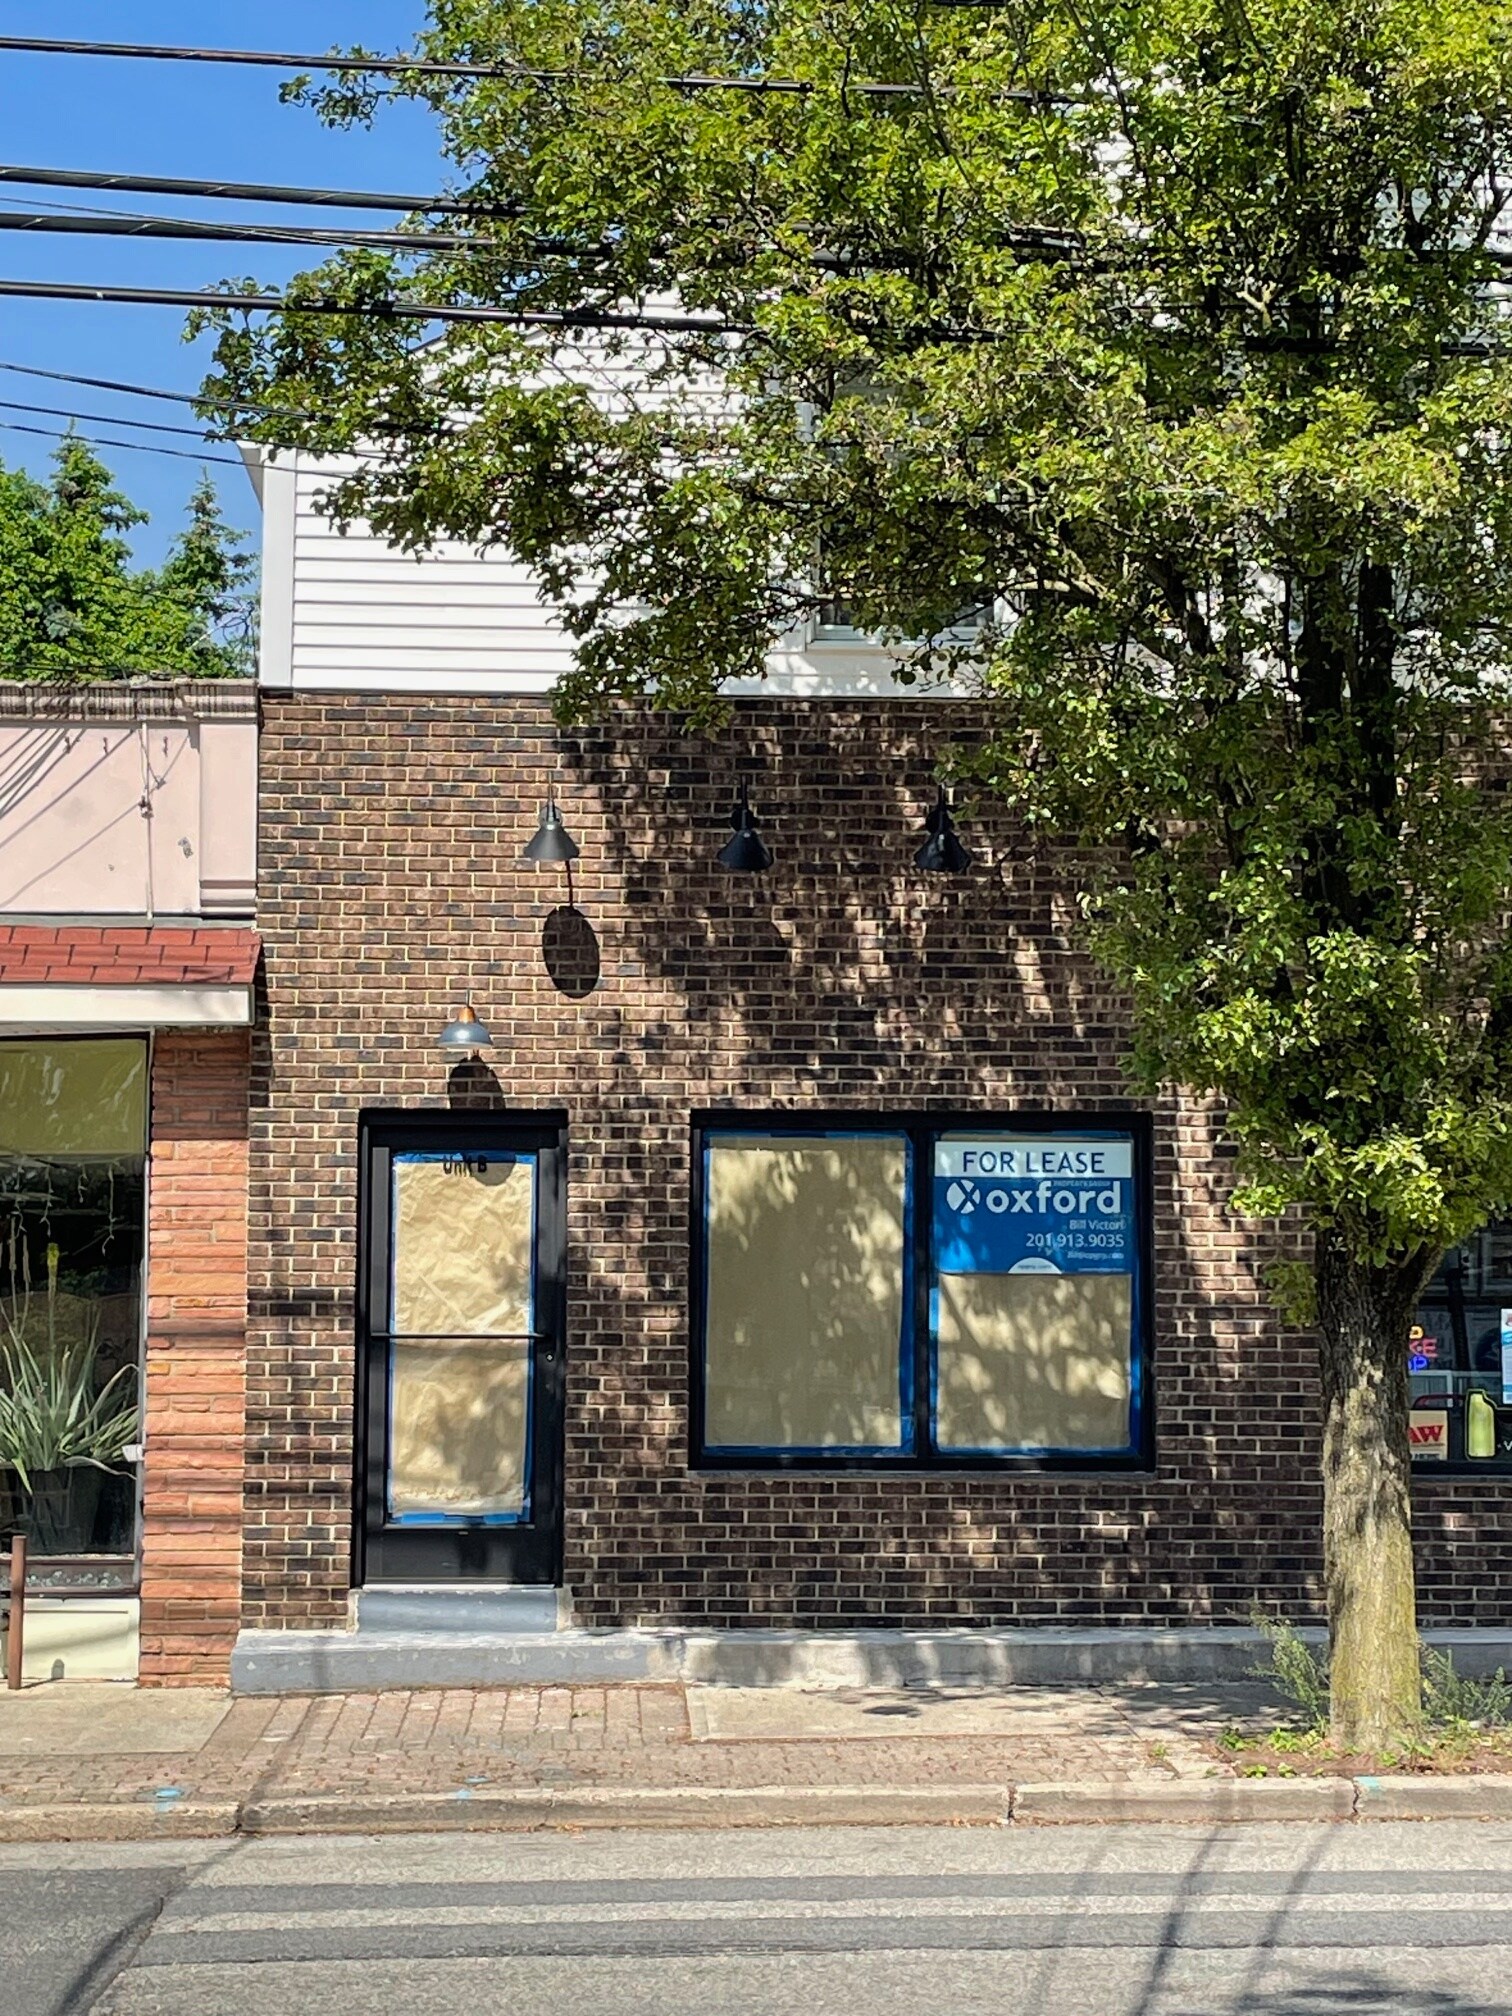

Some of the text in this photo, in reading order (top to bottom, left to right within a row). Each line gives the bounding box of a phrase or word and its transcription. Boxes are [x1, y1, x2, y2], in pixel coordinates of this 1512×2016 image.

[963, 1151, 1105, 1174] FOR LEASE
[985, 1180, 1121, 1214] oxford
[1408, 1425, 1444, 1444] AW
